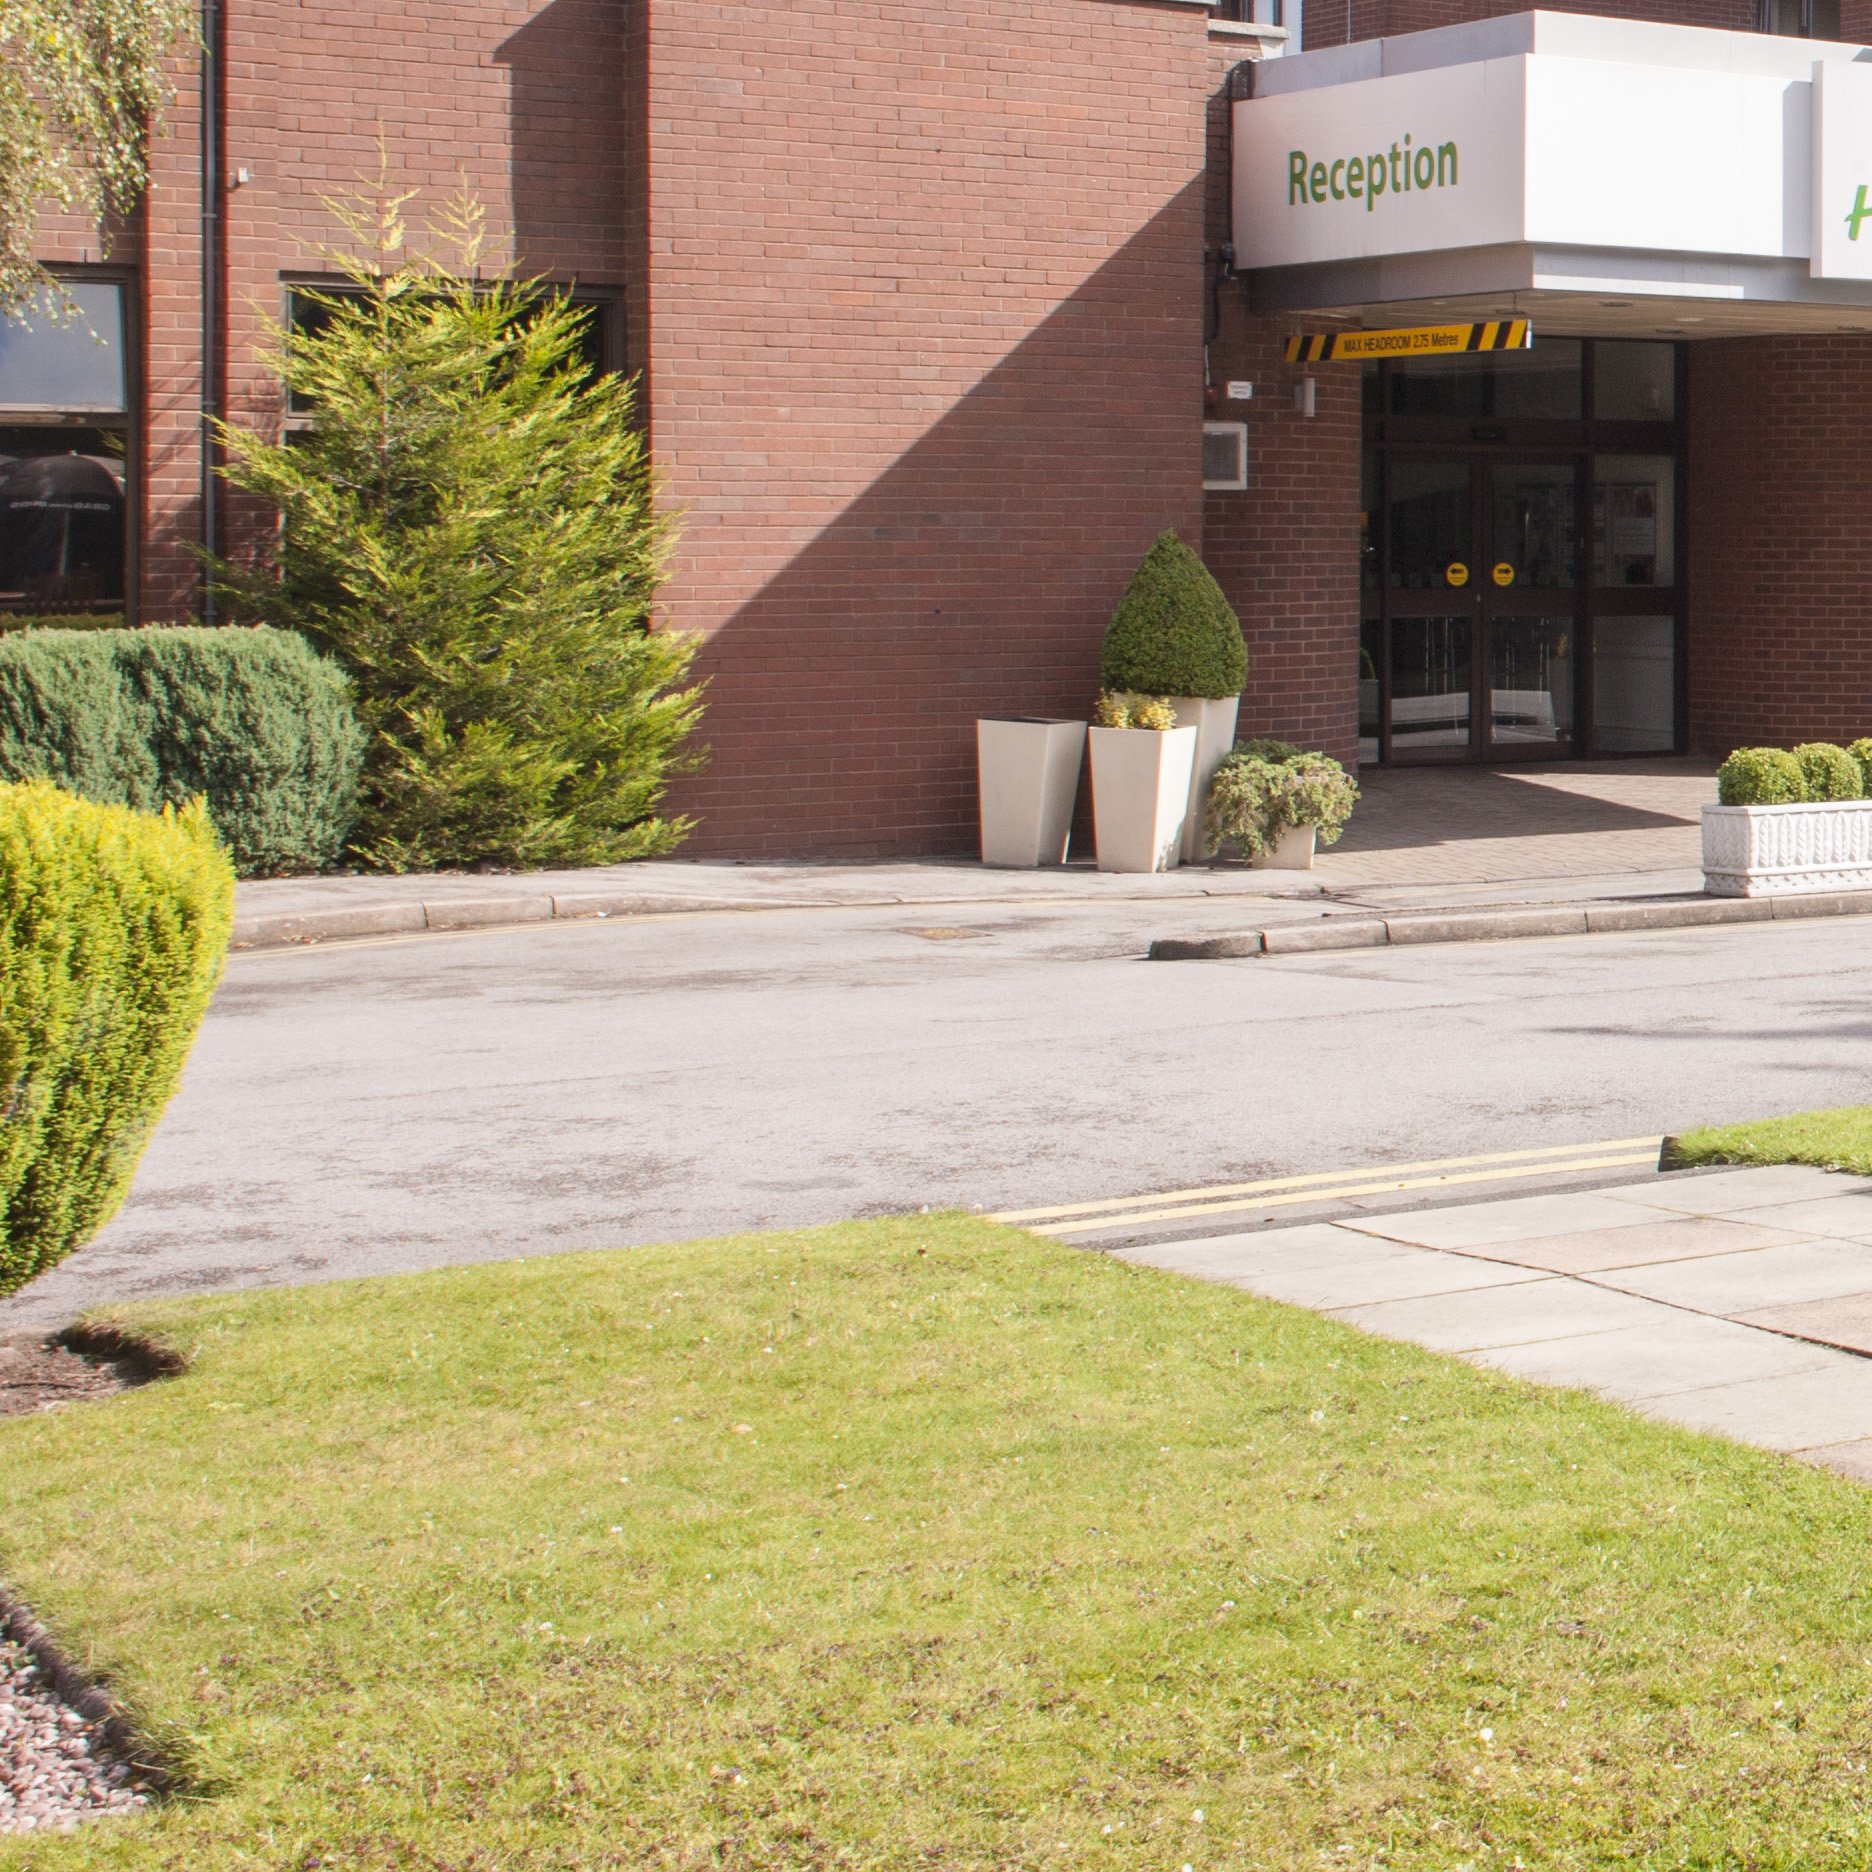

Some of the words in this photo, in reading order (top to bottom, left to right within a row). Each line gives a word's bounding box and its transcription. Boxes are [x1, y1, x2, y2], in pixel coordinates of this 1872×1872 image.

[1288, 132, 1459, 212] Reception
[1343, 338, 1362, 353] MAX
[1363, 335, 1412, 352] HEADROOM
[1431, 332, 1459, 347] Metres
